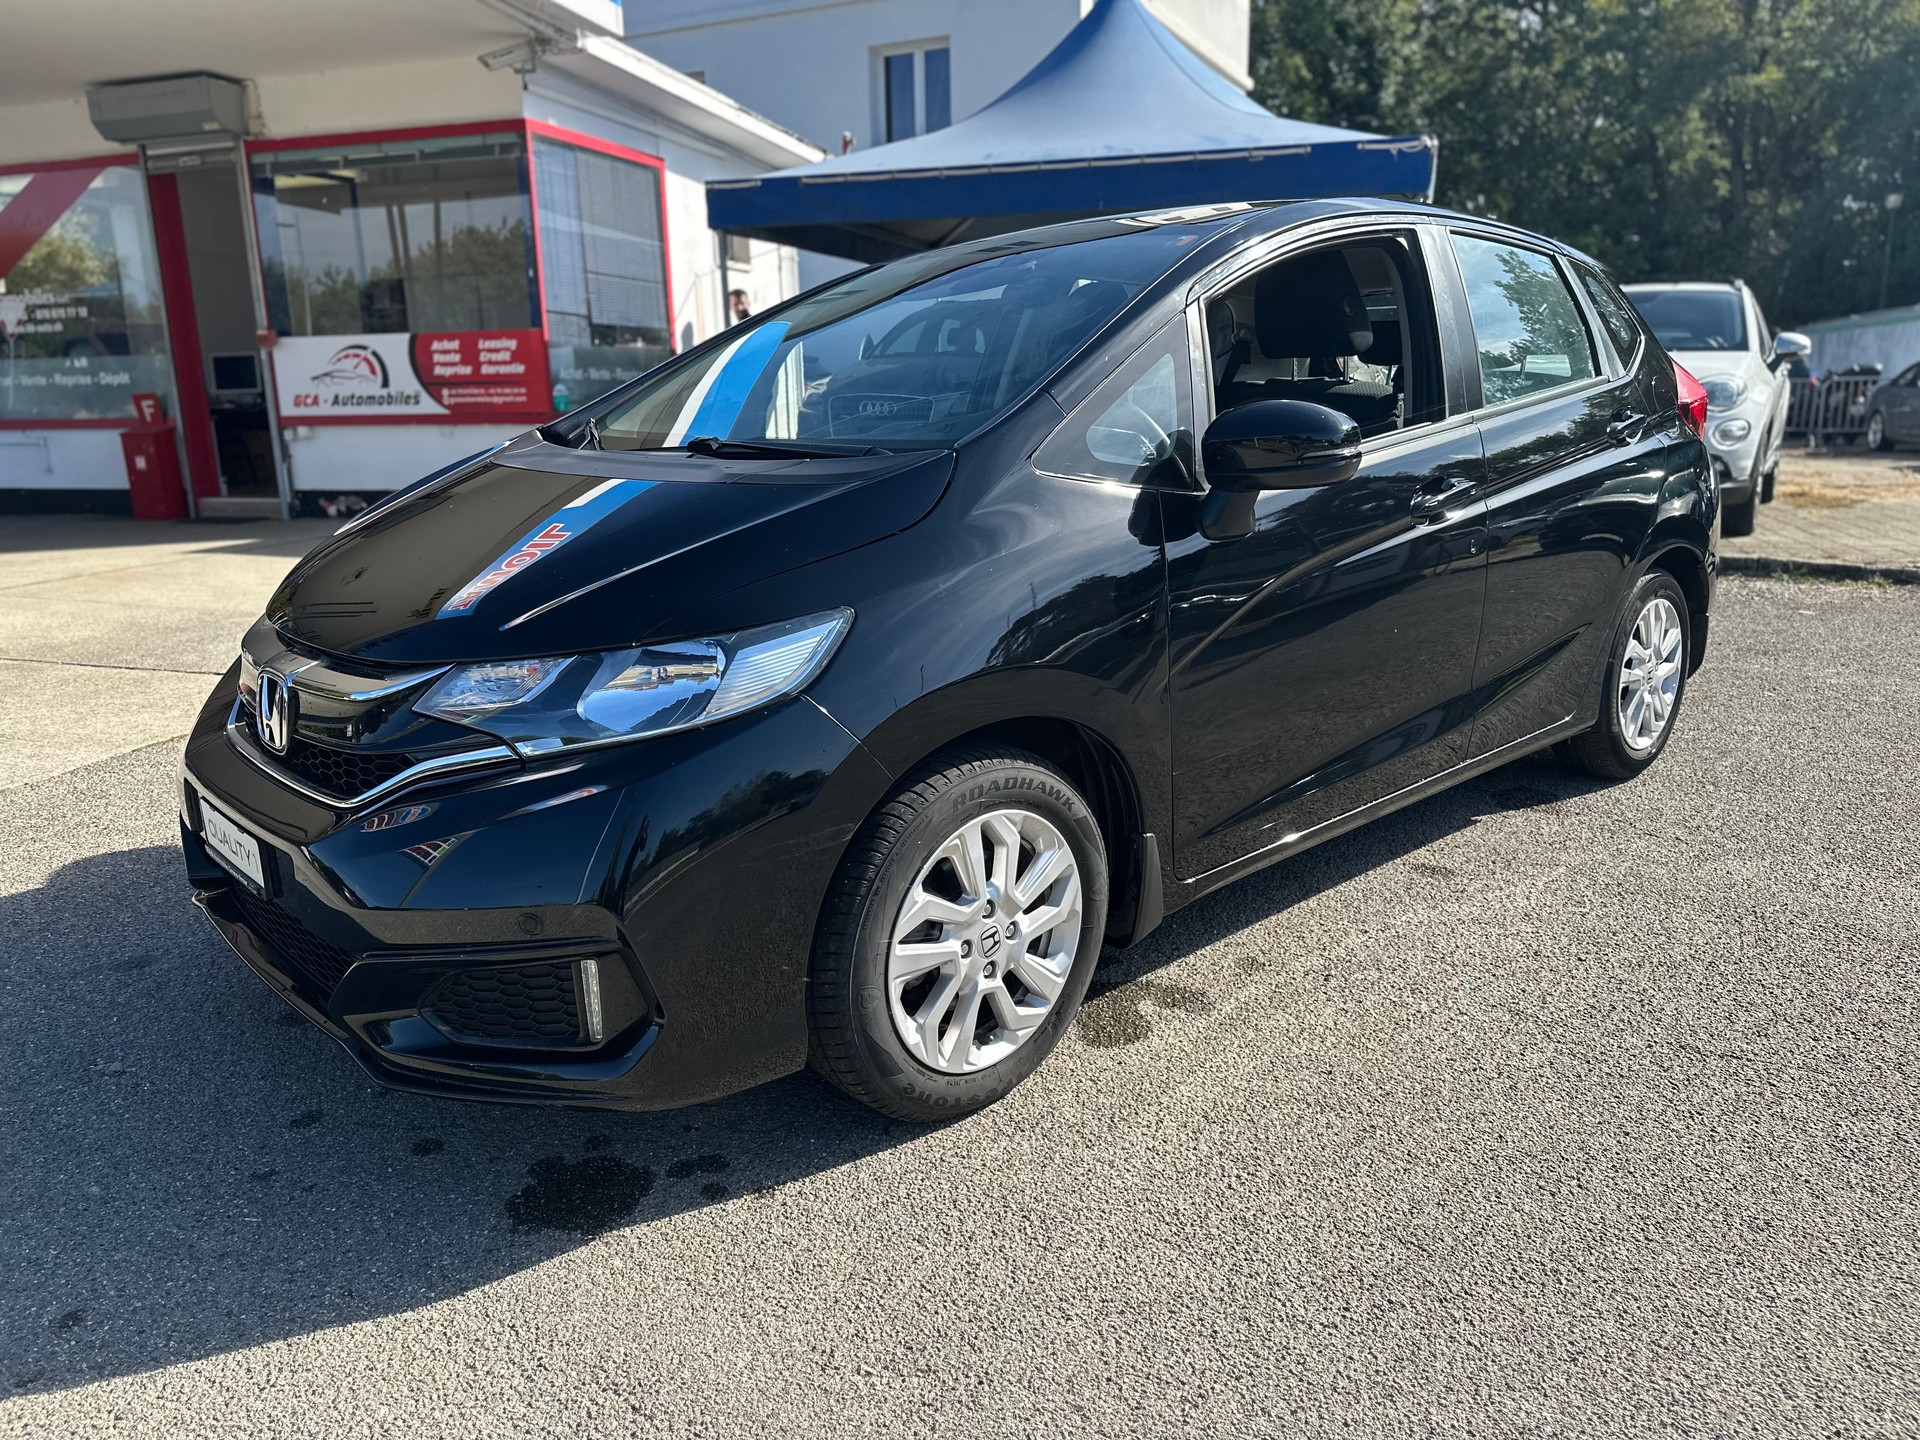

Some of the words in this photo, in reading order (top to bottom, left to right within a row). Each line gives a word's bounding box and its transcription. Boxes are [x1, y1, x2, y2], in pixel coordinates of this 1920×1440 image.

[431, 339, 460, 351] Achat
[478, 337, 518, 351] Leasing
[432, 352, 461, 363] Vente
[433, 364, 473, 378] Reprise
[480, 363, 526, 375] Garantie
[54, 372, 92, 388] Reprise
[293, 394, 319, 407] GCA
[331, 391, 421, 407] Automobiles
[141, 400, 155, 422] F
[952, 776, 1076, 813] ROADHAWK
